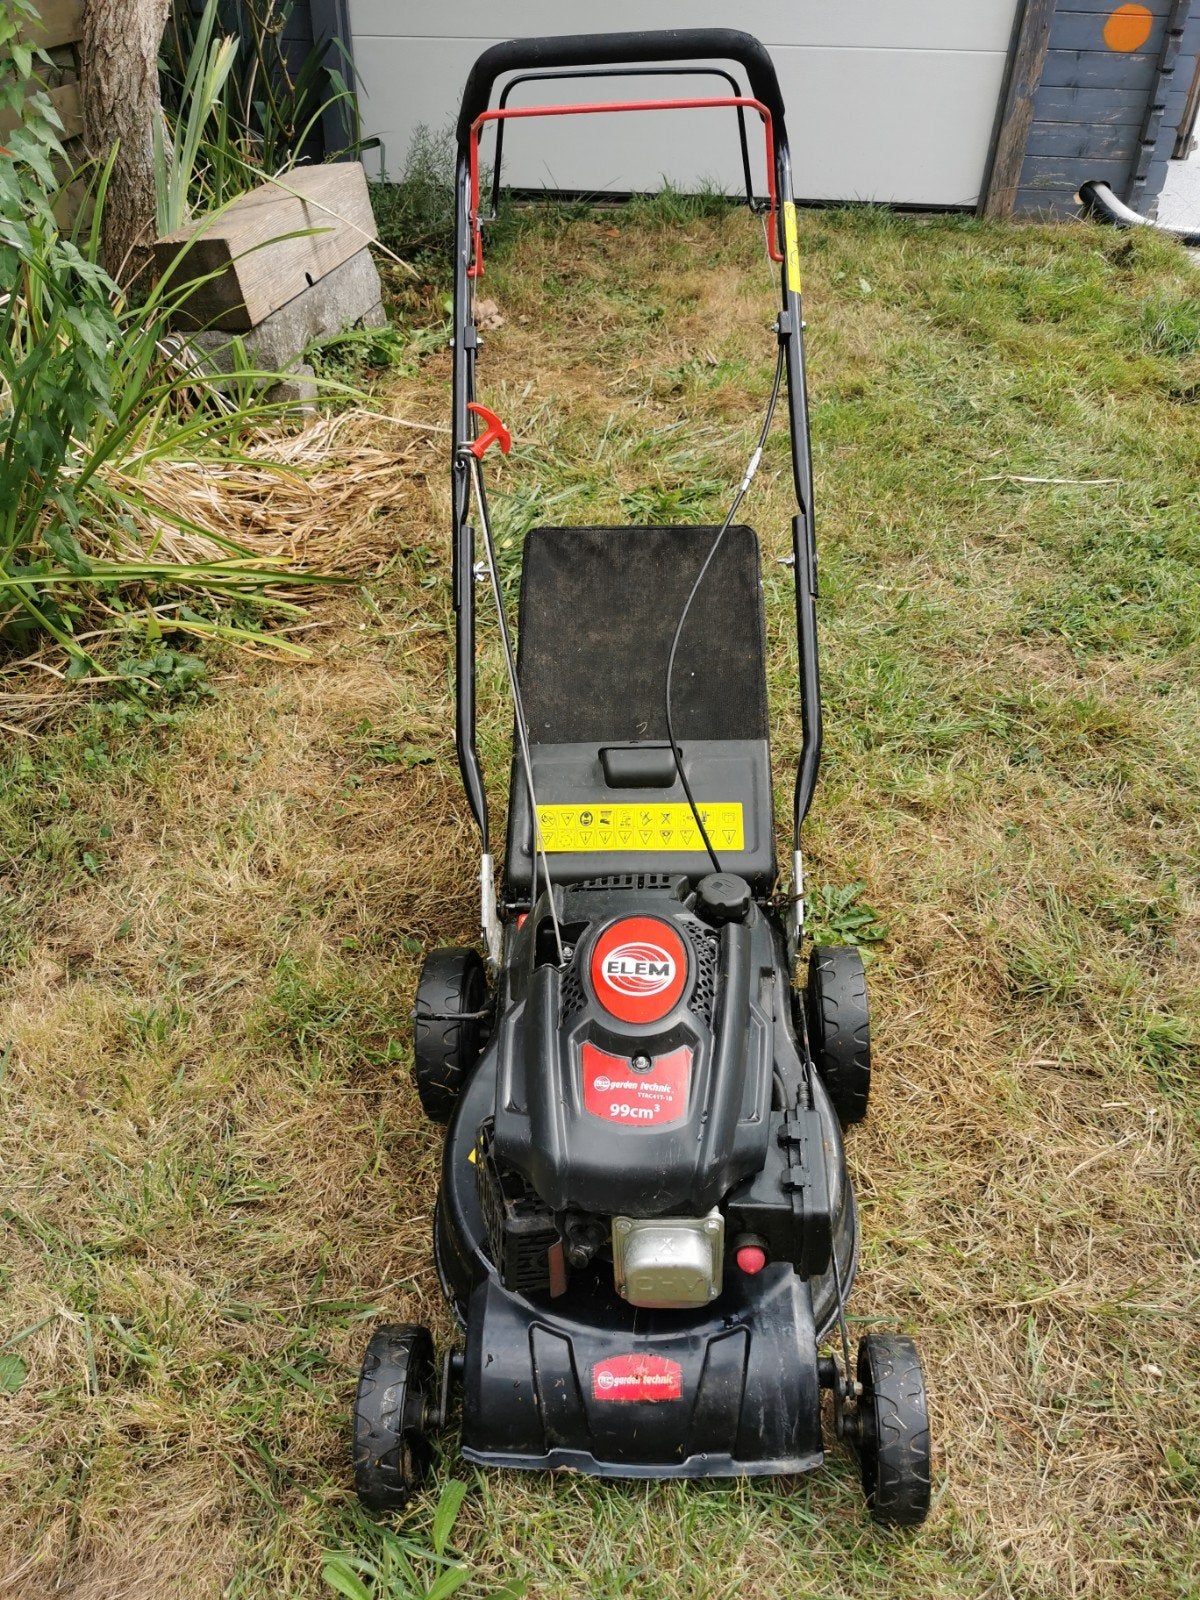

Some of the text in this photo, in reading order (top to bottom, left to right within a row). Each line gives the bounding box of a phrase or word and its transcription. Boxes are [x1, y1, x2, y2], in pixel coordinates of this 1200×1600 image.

[607, 961, 670, 977] ELEM
[609, 1080, 639, 1091] garden
[640, 1081, 672, 1093] technic
[636, 1275, 705, 1293] OHV
[613, 1374, 640, 1387] garden
[642, 1373, 674, 1385] technic
